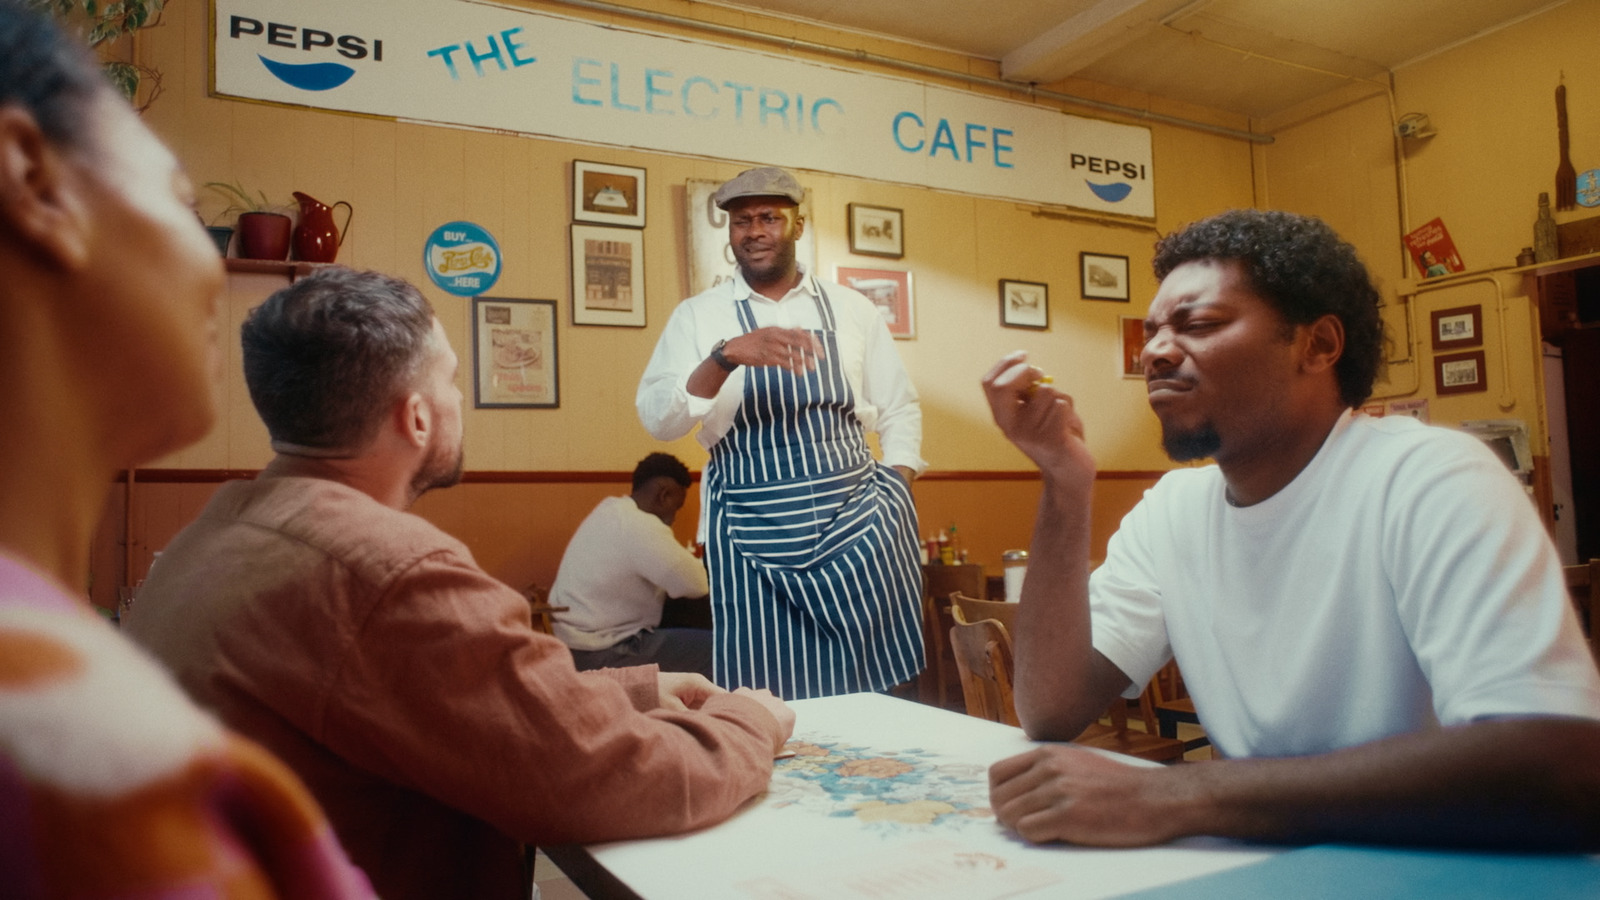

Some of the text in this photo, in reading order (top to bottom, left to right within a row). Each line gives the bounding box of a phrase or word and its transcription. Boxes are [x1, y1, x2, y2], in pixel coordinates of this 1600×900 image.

[229, 15, 383, 62] PEPSI
[427, 26, 1015, 169] THE ELECTRIC CAFE
[1070, 153, 1146, 181] PEPSI
